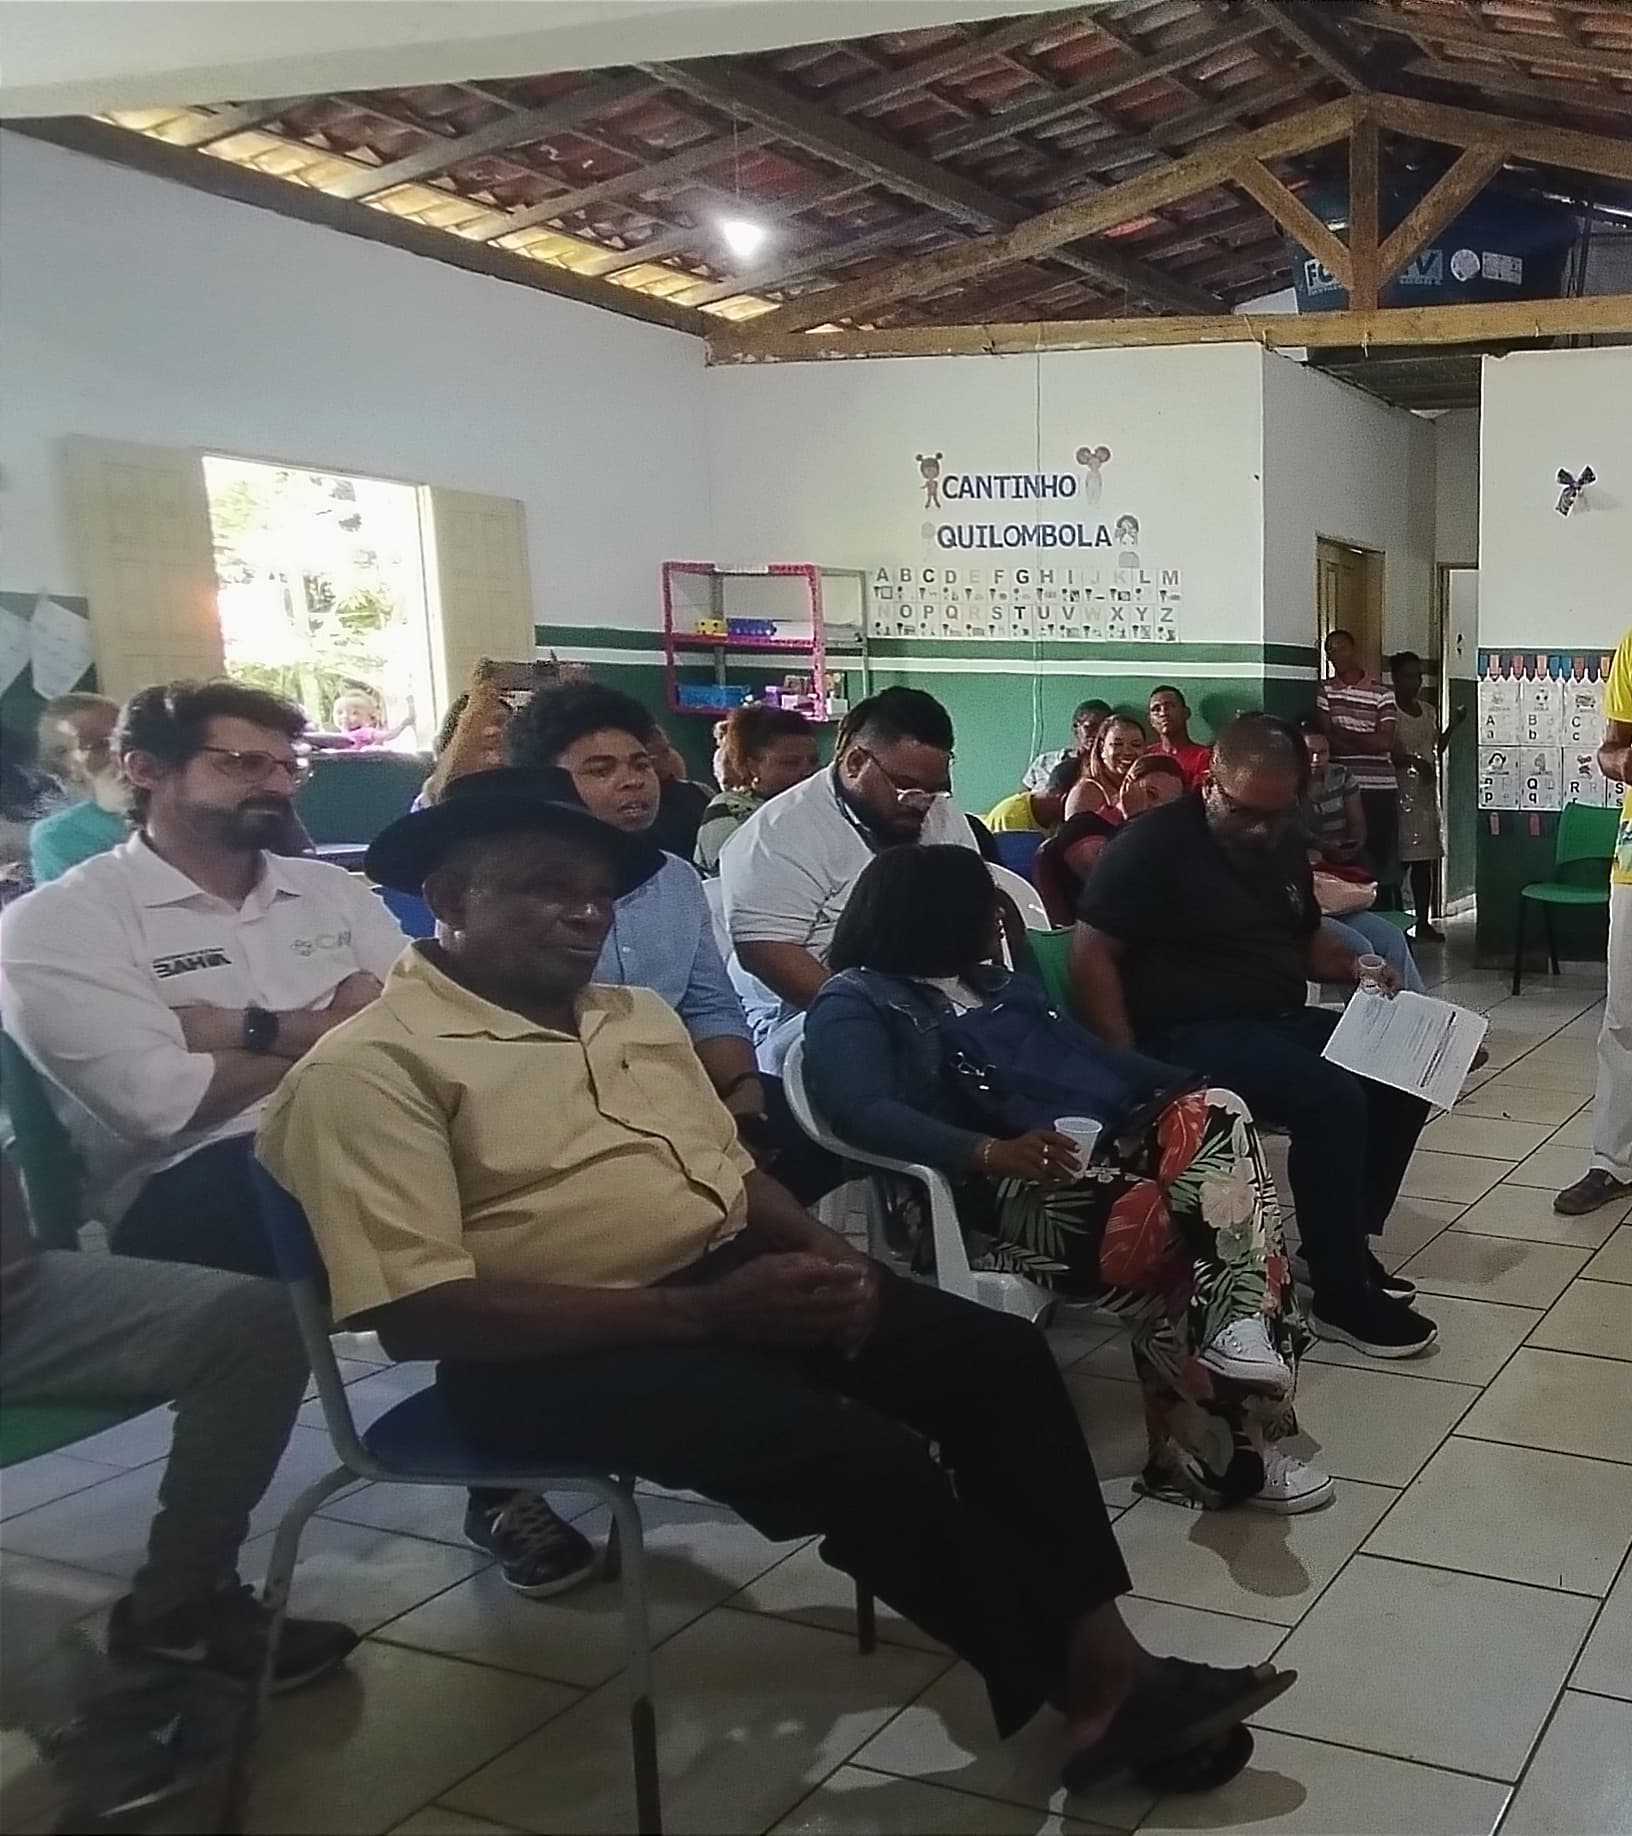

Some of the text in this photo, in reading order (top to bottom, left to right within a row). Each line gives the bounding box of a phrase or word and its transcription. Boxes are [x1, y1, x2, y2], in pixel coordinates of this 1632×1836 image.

[942, 475, 1077, 499] CANTINHO
[937, 523, 1112, 549] QUILOMBOLA
[877, 568, 889, 581] A
[900, 568, 912, 582] B
[922, 568, 935, 583] C
[945, 570, 957, 584] D
[994, 570, 1004, 584] F
[1015, 569, 1030, 584] G
[1040, 569, 1053, 584] H
[1139, 569, 1151, 584] L
[1162, 570, 1179, 585] M
[900, 604, 1173, 622] O P Q S T U V X Y Z
[1486, 715, 1495, 726] A
[1528, 714, 1537, 726] B
[1571, 716, 1581, 727] C
[1528, 729, 1537, 740] b
[1572, 732, 1580, 741] c
[1527, 778, 1538, 790] Q
[1570, 782, 1580, 793] R
[1484, 793, 1493, 804] p
[1528, 792, 1537, 804] q
